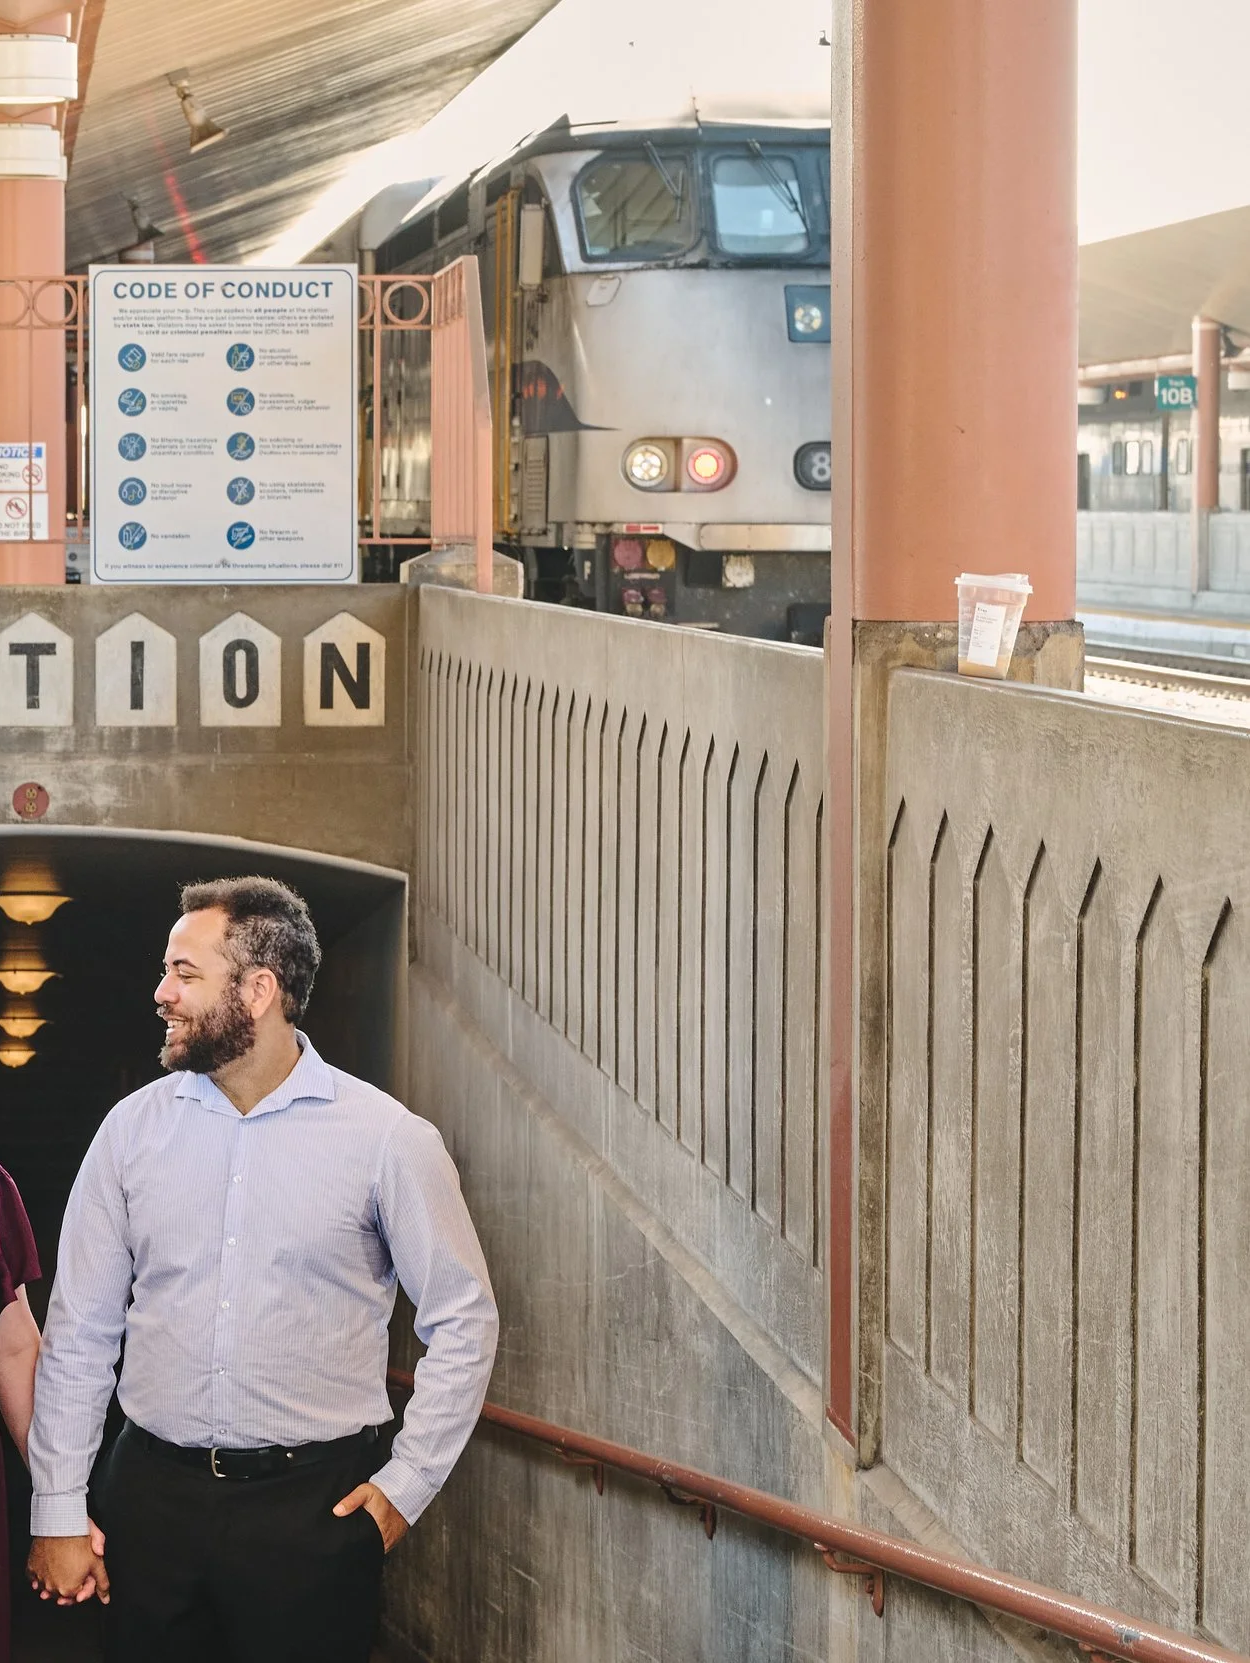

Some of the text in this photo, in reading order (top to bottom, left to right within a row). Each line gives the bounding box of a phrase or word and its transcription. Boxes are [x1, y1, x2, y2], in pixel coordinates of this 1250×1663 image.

[113, 282, 333, 299] CODE OF CONDUCT
[1162, 388, 1192, 404] 10B
